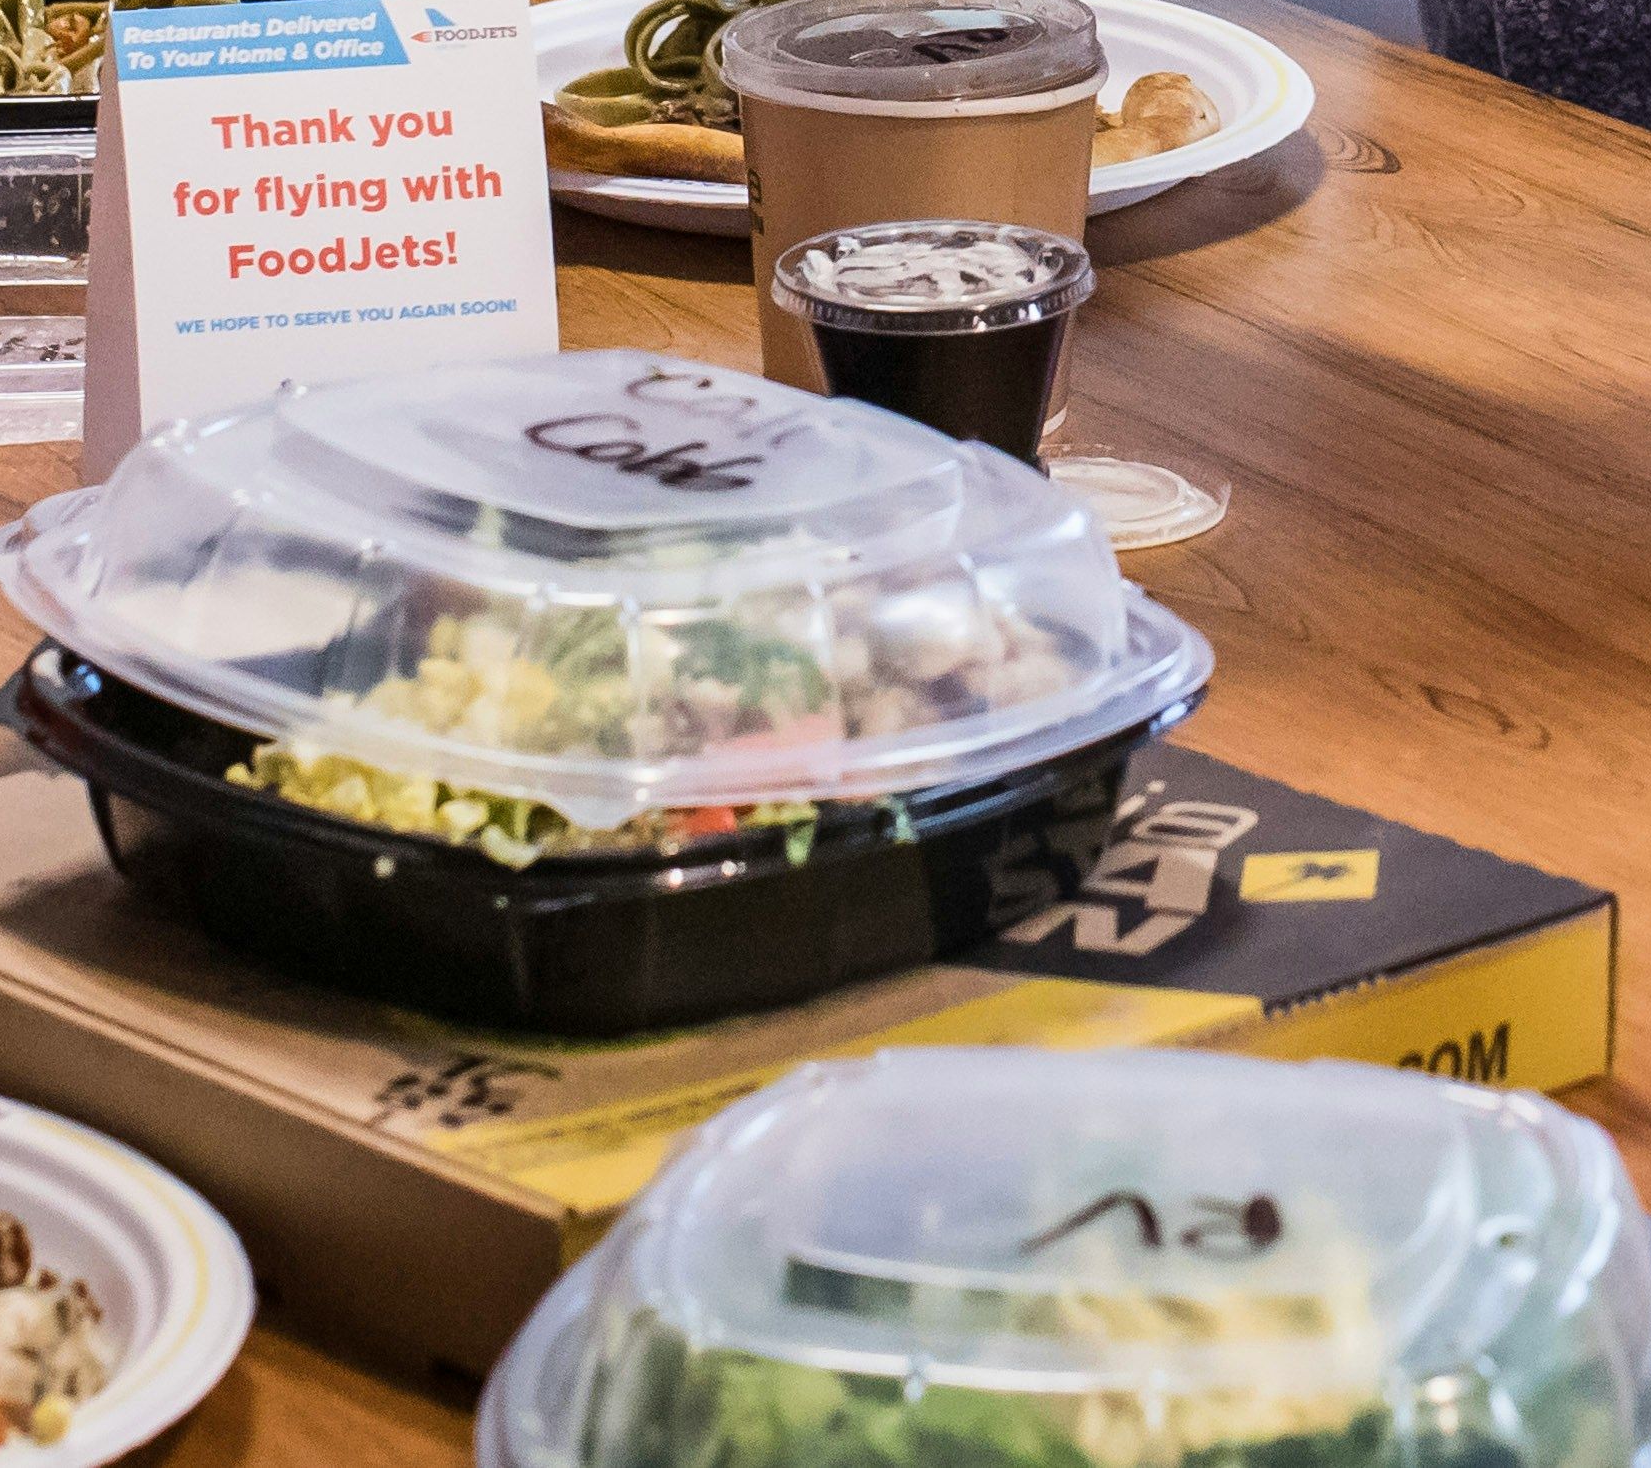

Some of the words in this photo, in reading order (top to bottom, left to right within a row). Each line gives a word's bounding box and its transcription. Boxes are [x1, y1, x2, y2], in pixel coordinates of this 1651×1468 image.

[123, 20, 262, 45] Restaurants
[266, 12, 377, 37] Delivered
[434, 26, 518, 42] FOODJETS
[127, 51, 156, 70] To
[162, 49, 215, 68] Your
[218, 46, 288, 65] Home
[291, 40, 309, 60] &
[314, 38, 385, 60] Office
[211, 108, 356, 149] Thank
[368, 108, 454, 148] you
[173, 180, 240, 217] for
[254, 172, 388, 218] flying
[402, 163, 503, 203] with
[228, 231, 458, 280] FoodJets!
[175, 319, 205, 334] WE
[211, 315, 260, 332] HOPE
[265, 314, 289, 328] TO
[294, 310, 351, 326] SERVE
[357, 307, 395, 322] YOU
[399, 303, 456, 319] AGAIN
[460, 298, 518, 316] SOON!
